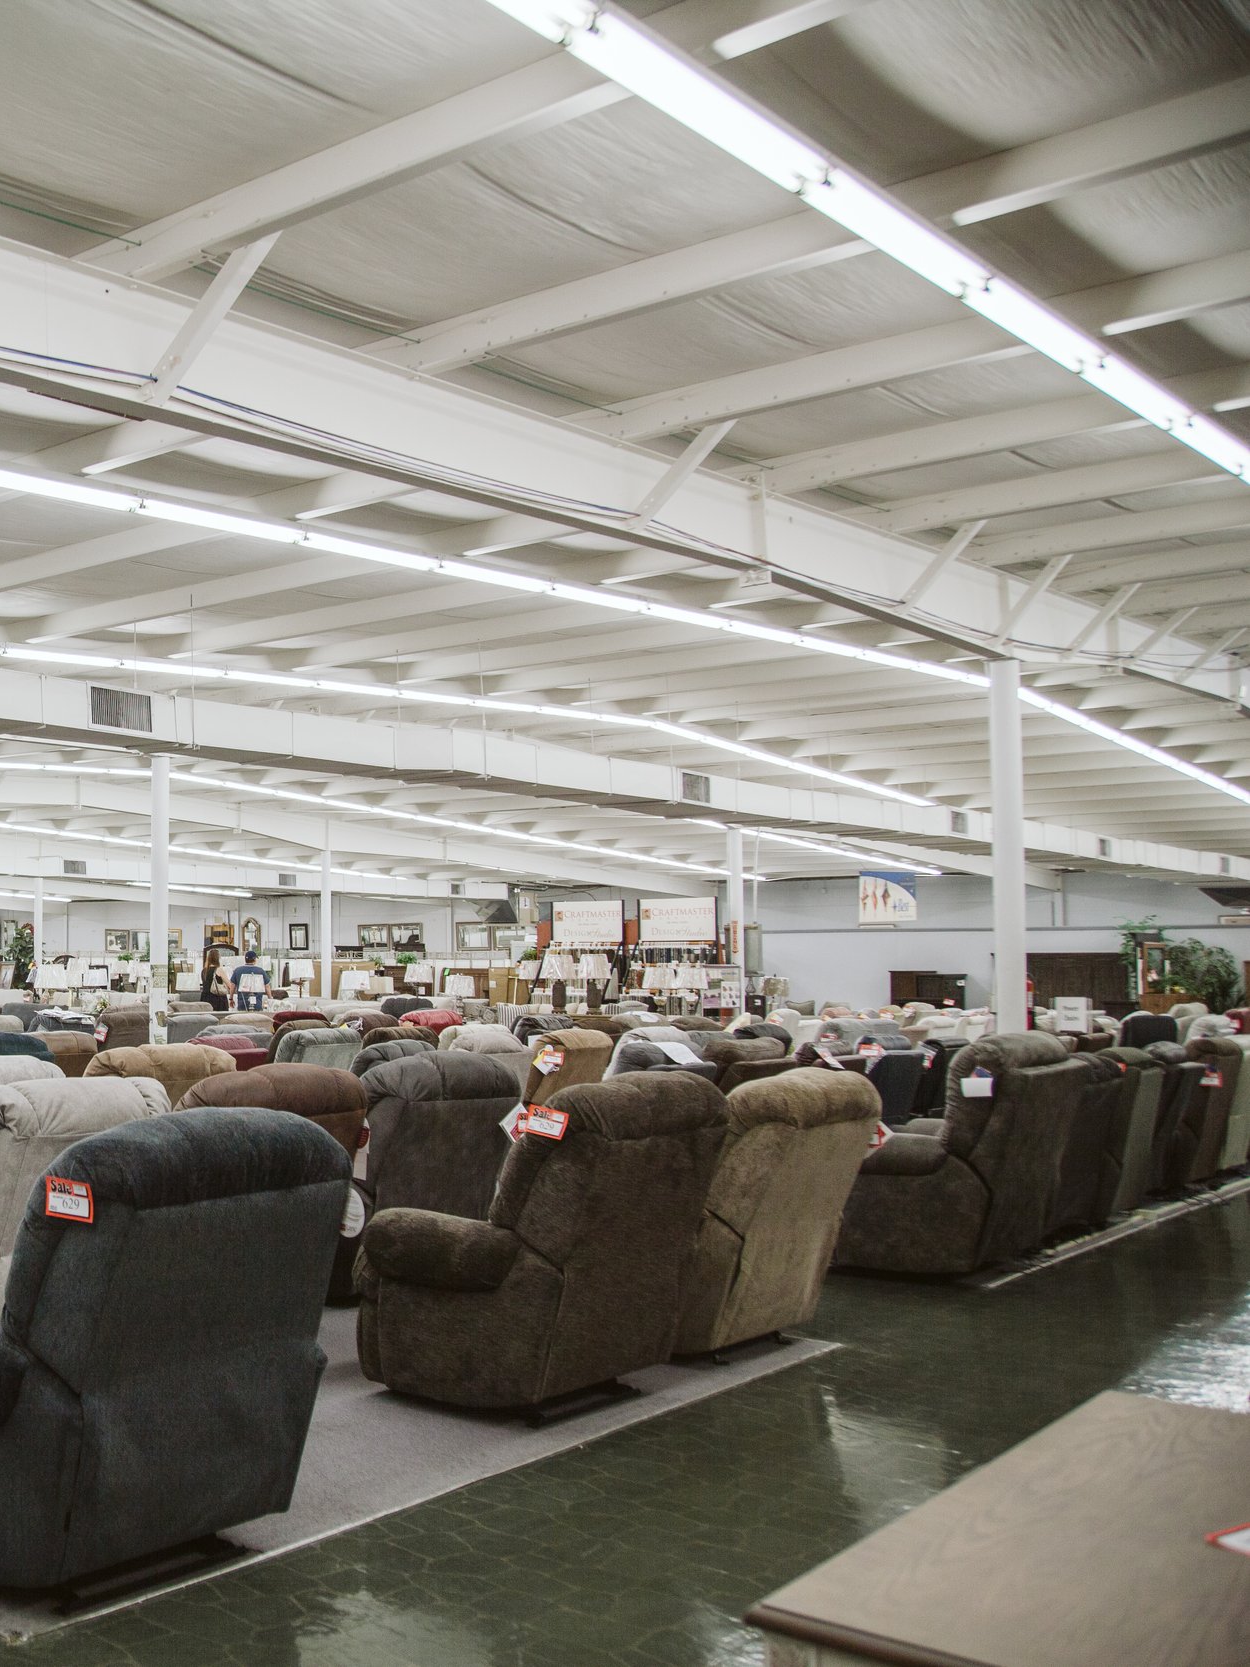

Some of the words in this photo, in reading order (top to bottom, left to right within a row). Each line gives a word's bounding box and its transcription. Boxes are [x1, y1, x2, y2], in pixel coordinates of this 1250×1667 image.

[564, 910, 622, 919] CRAFTMASTER
[651, 907, 714, 917] CRAFTMASTER
[533, 1107, 551, 1120] Sale
[51, 1180, 72, 1194] Sale
[62, 1198, 80, 1210] 629
